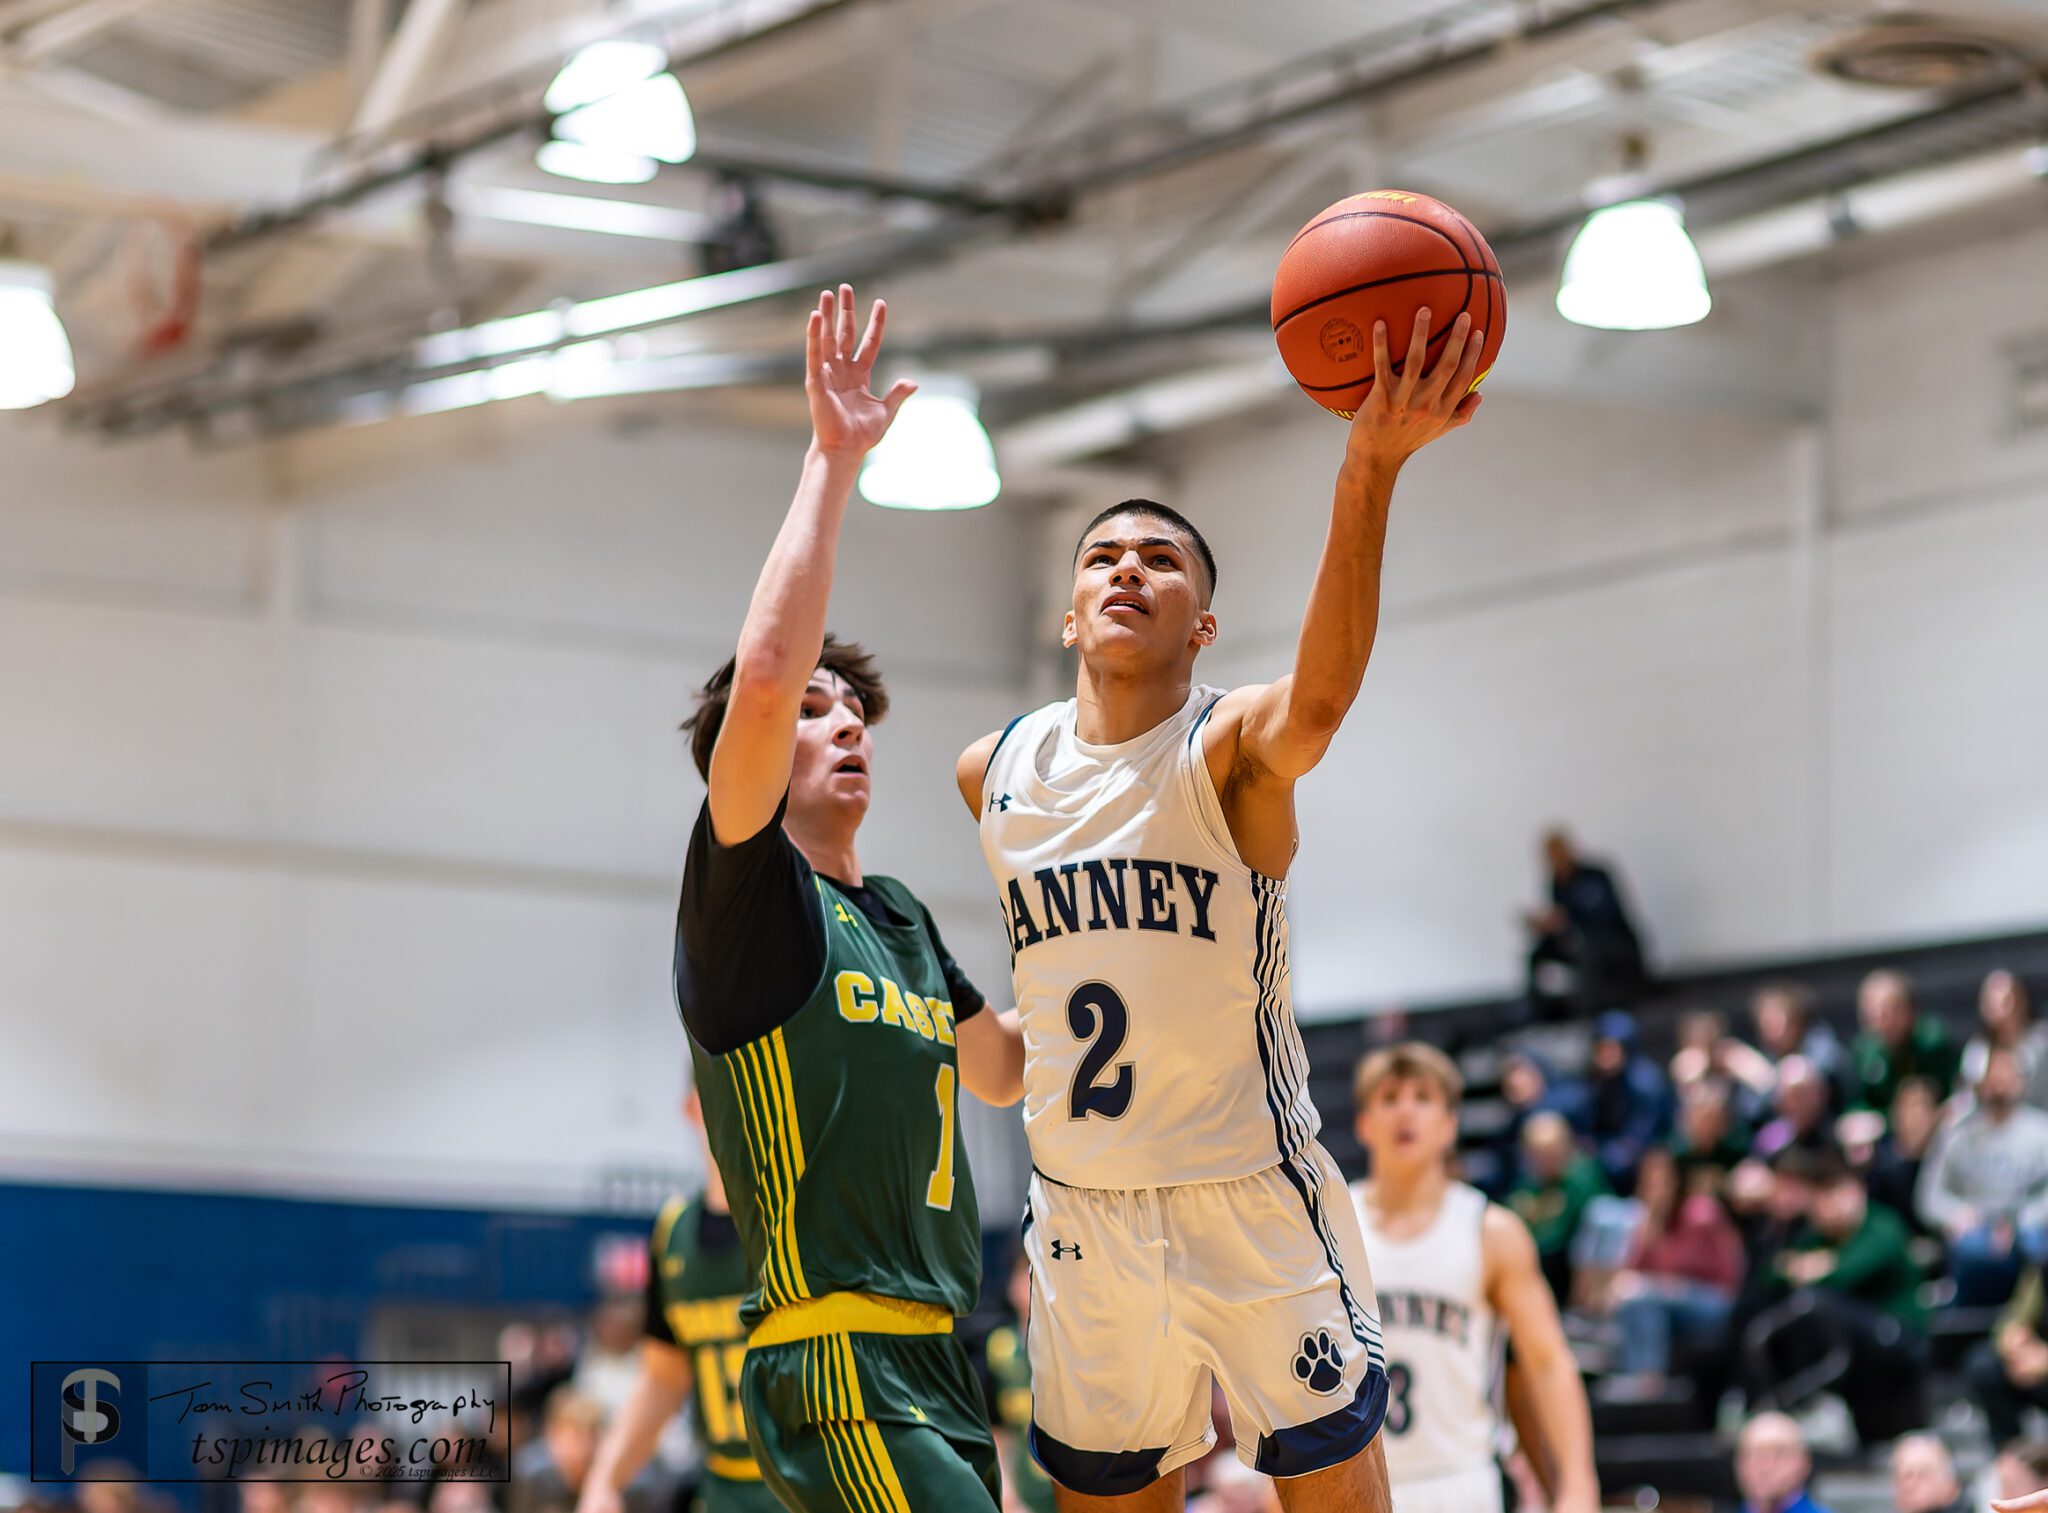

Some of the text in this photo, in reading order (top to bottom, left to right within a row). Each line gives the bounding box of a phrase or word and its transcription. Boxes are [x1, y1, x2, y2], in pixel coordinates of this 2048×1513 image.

[1000, 857, 1220, 962] ANNEY
[1065, 978, 1136, 1122] 2
[926, 1063, 955, 1212] 1
